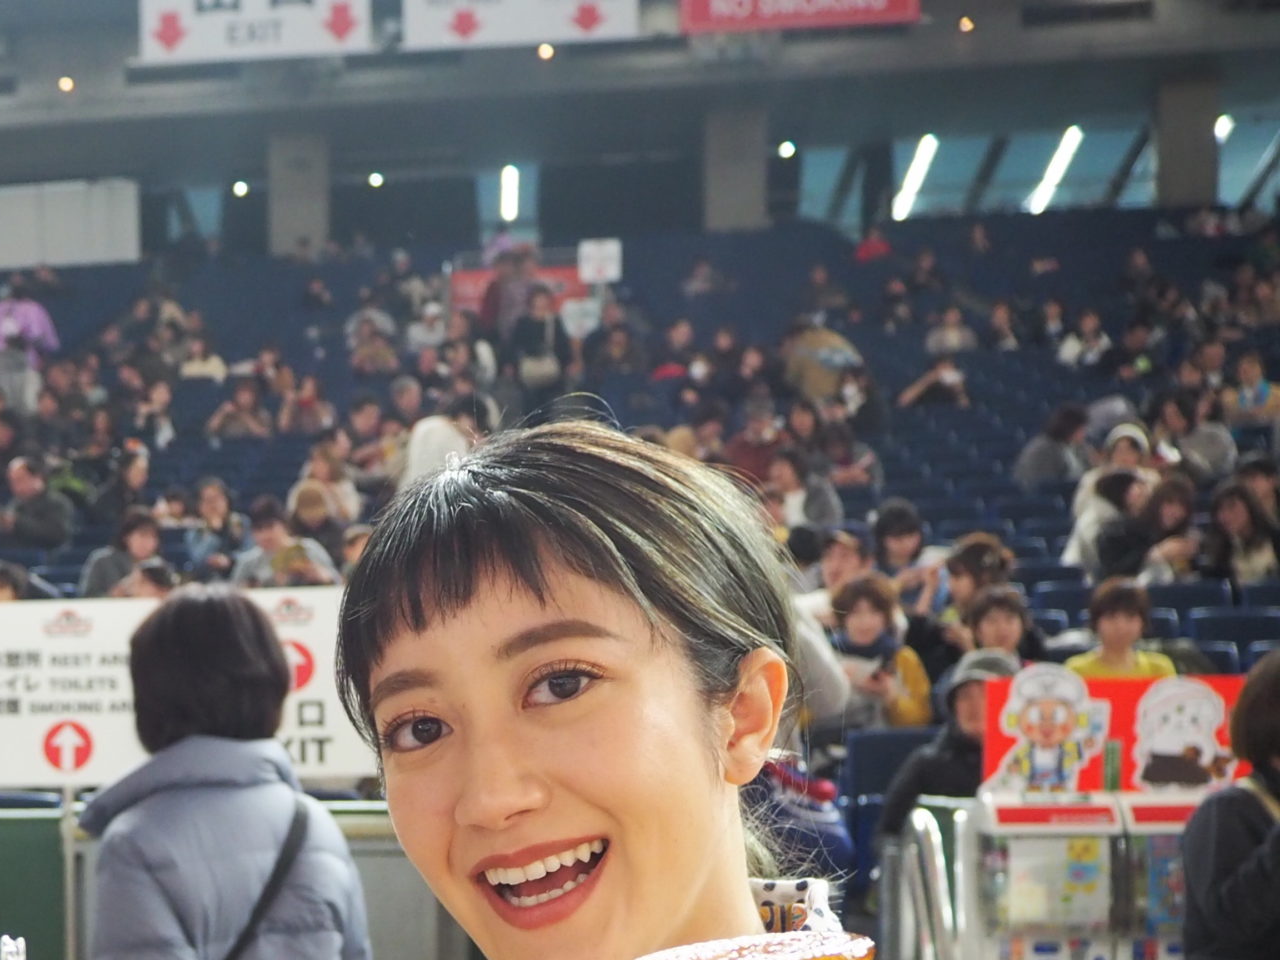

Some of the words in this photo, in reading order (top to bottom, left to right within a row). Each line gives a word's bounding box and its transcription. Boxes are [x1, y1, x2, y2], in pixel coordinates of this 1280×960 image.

[225, 18, 283, 46] EXIT
[49, 677, 118, 691] TOILETS
[280, 736, 333, 764] XIT
